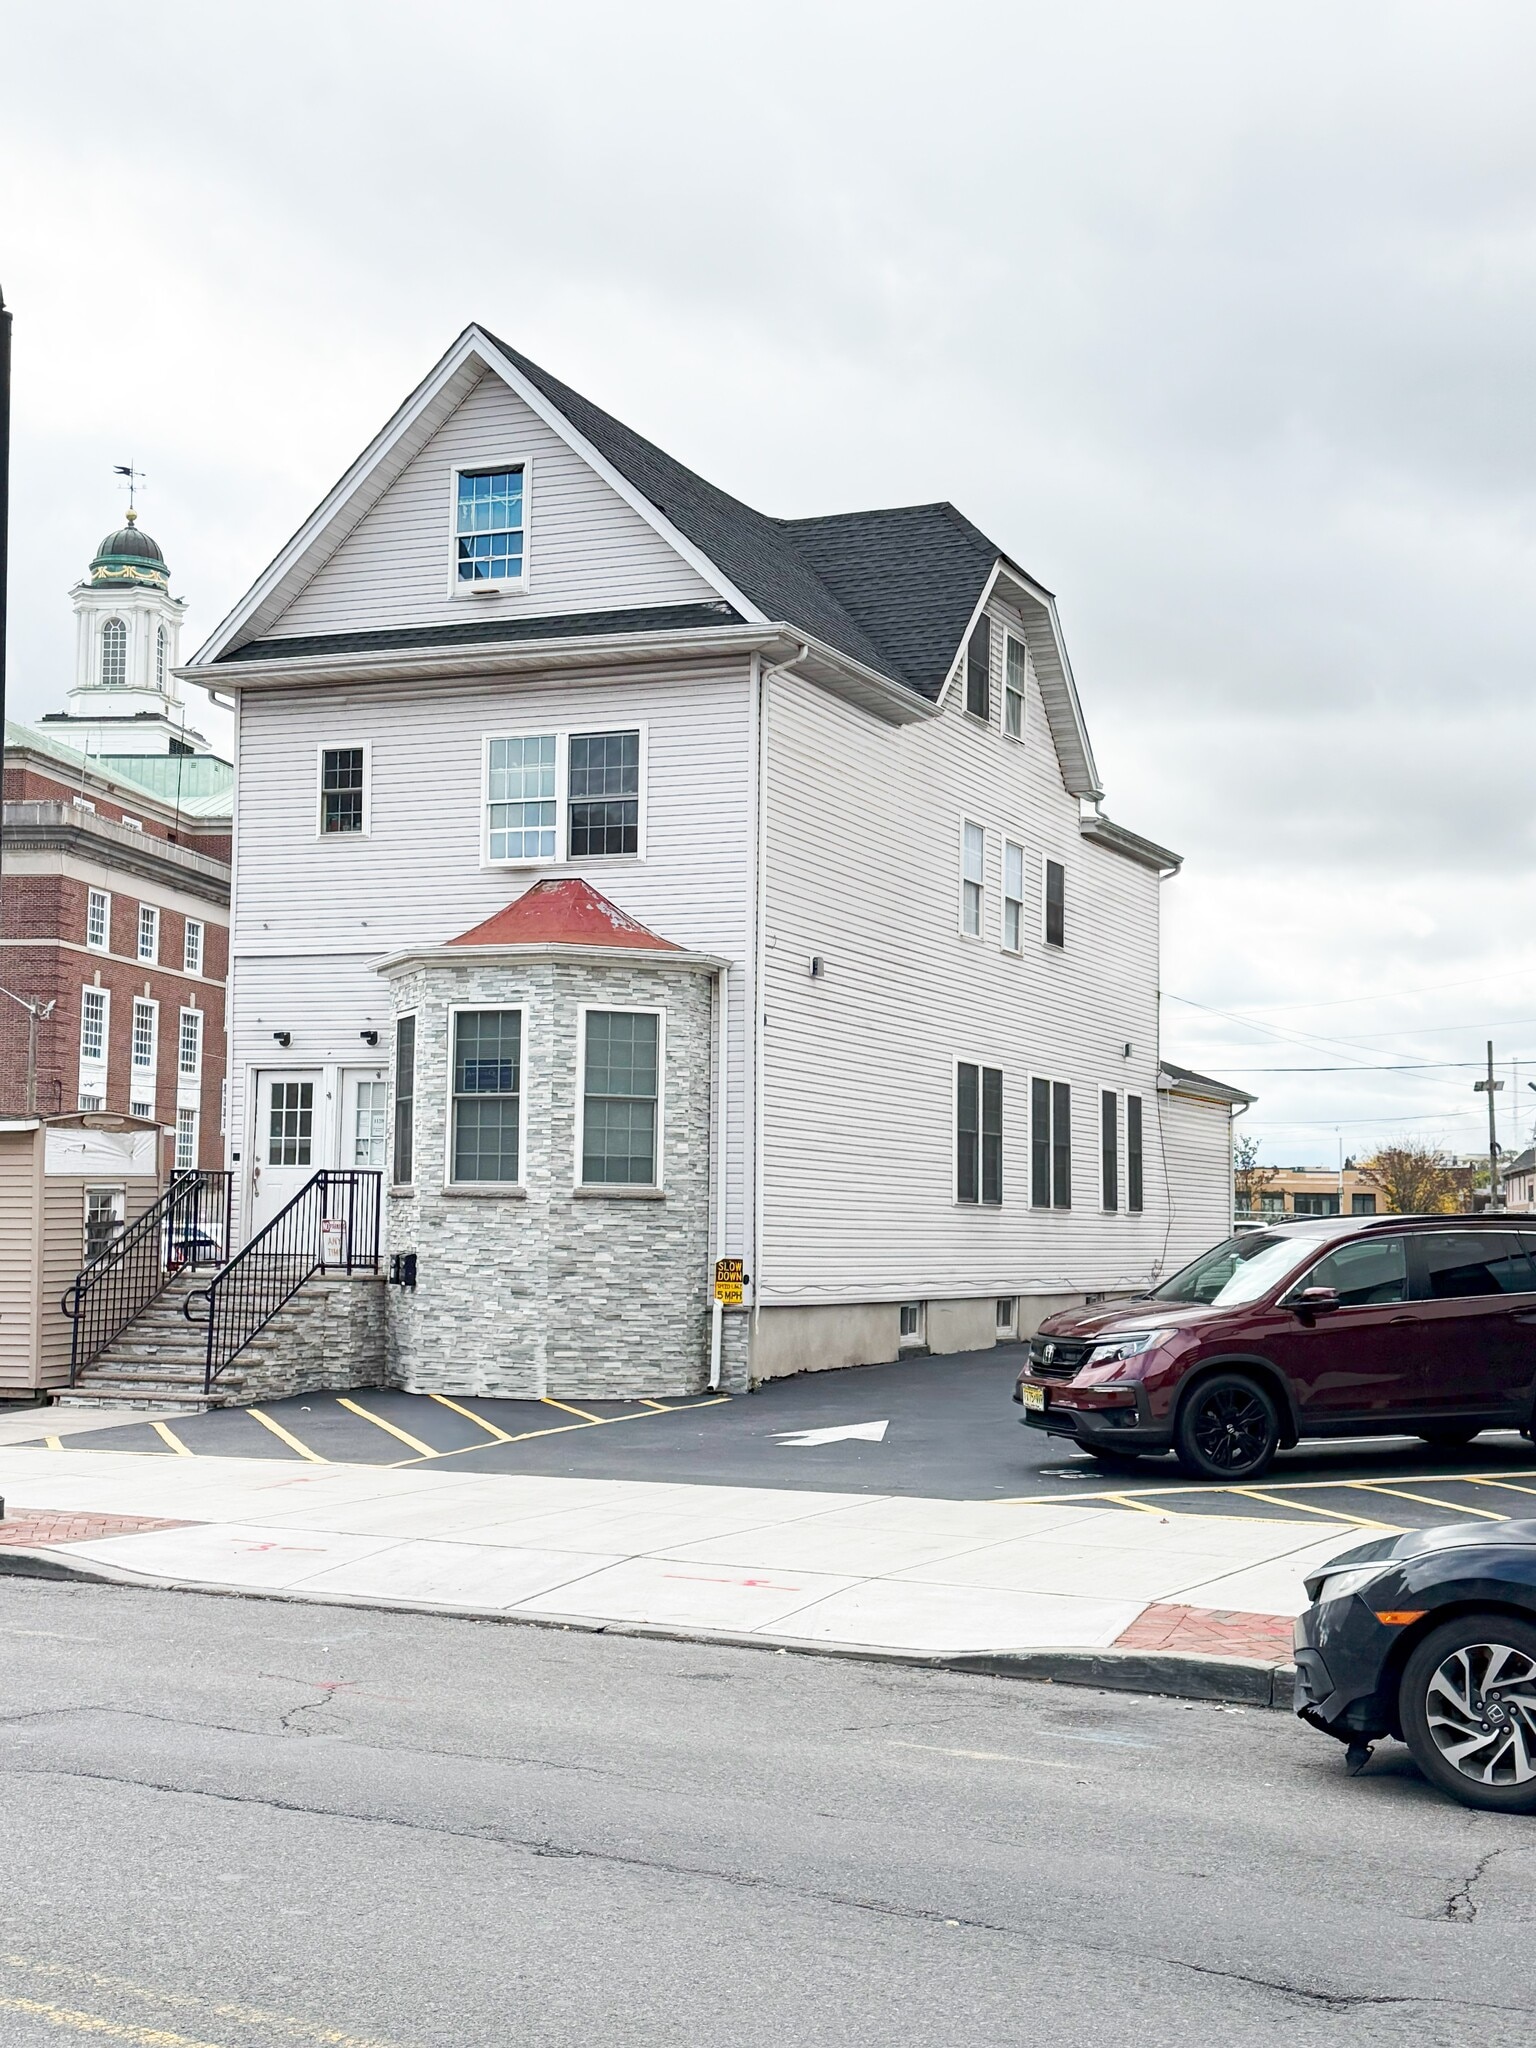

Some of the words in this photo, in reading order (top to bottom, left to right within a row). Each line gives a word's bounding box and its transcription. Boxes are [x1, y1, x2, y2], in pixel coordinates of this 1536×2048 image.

[328, 1248, 343, 1257] TIM
[718, 1261, 742, 1271] SLOW
[717, 1271, 742, 1281] DOWN
[717, 1290, 724, 1300] 5
[724, 1291, 743, 1300] MPH
